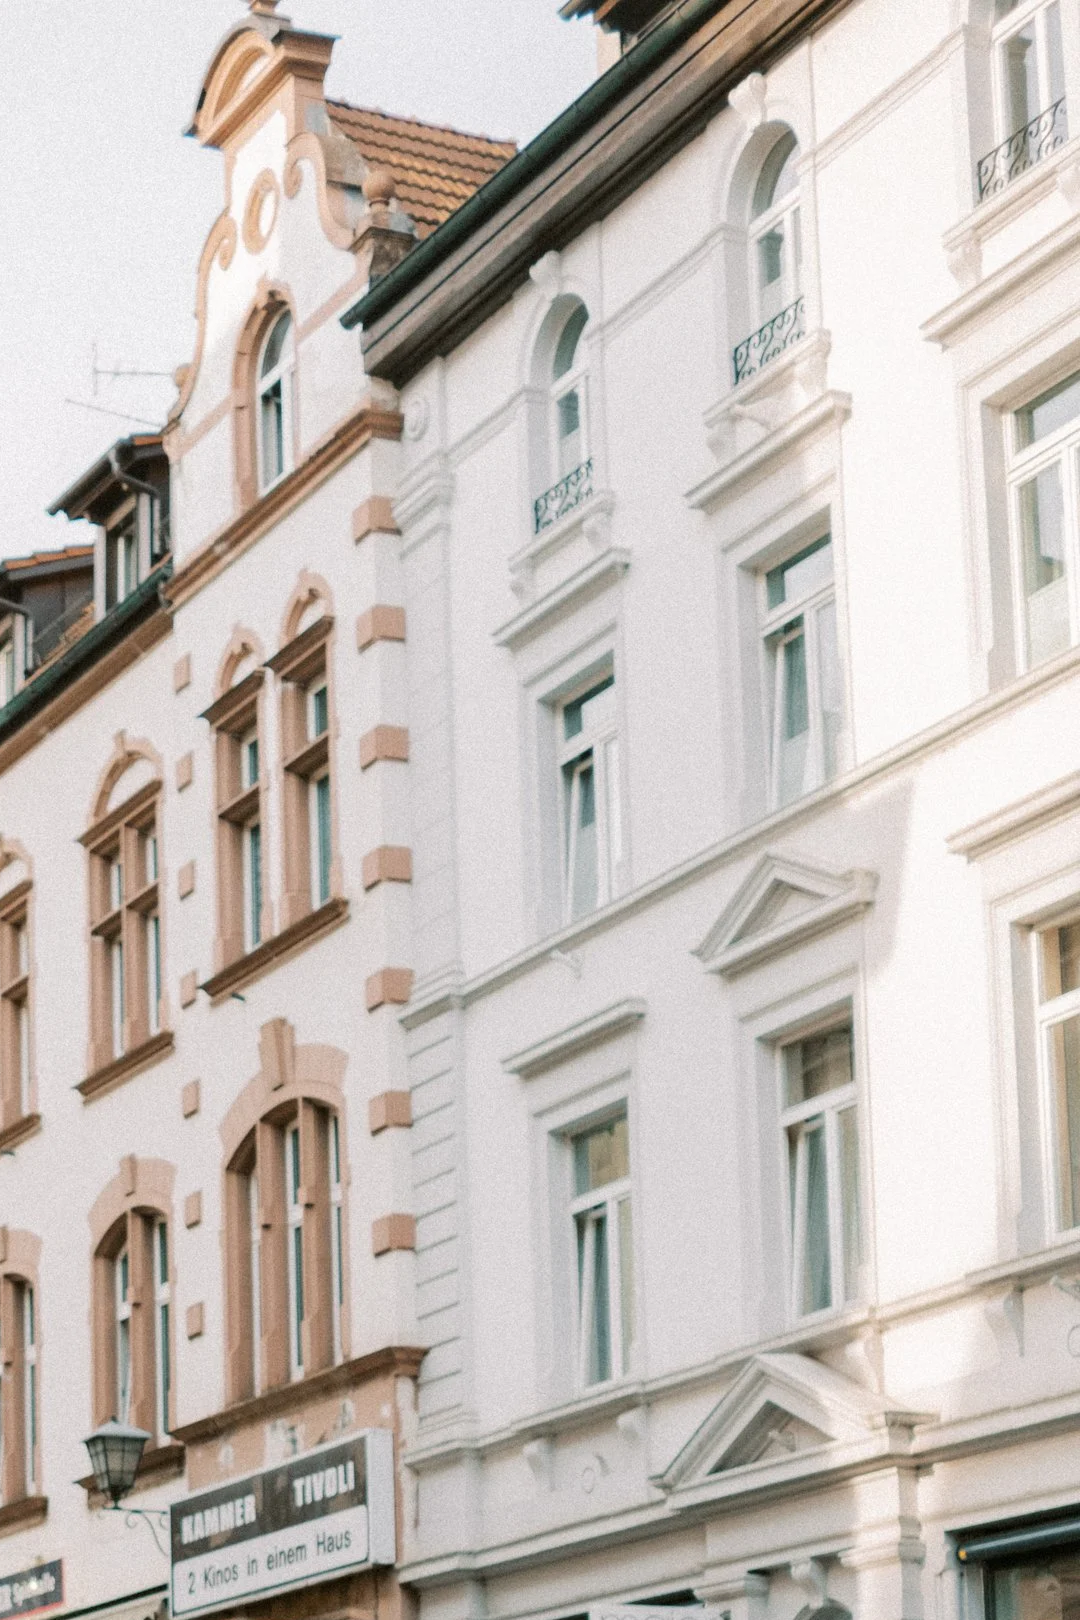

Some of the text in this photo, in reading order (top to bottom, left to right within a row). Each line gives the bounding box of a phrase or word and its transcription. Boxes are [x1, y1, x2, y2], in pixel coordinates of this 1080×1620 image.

[181, 1459, 355, 1545] KAMMER TIVOLI
[187, 1530, 352, 1595] 2 Kinos in einem Haus
